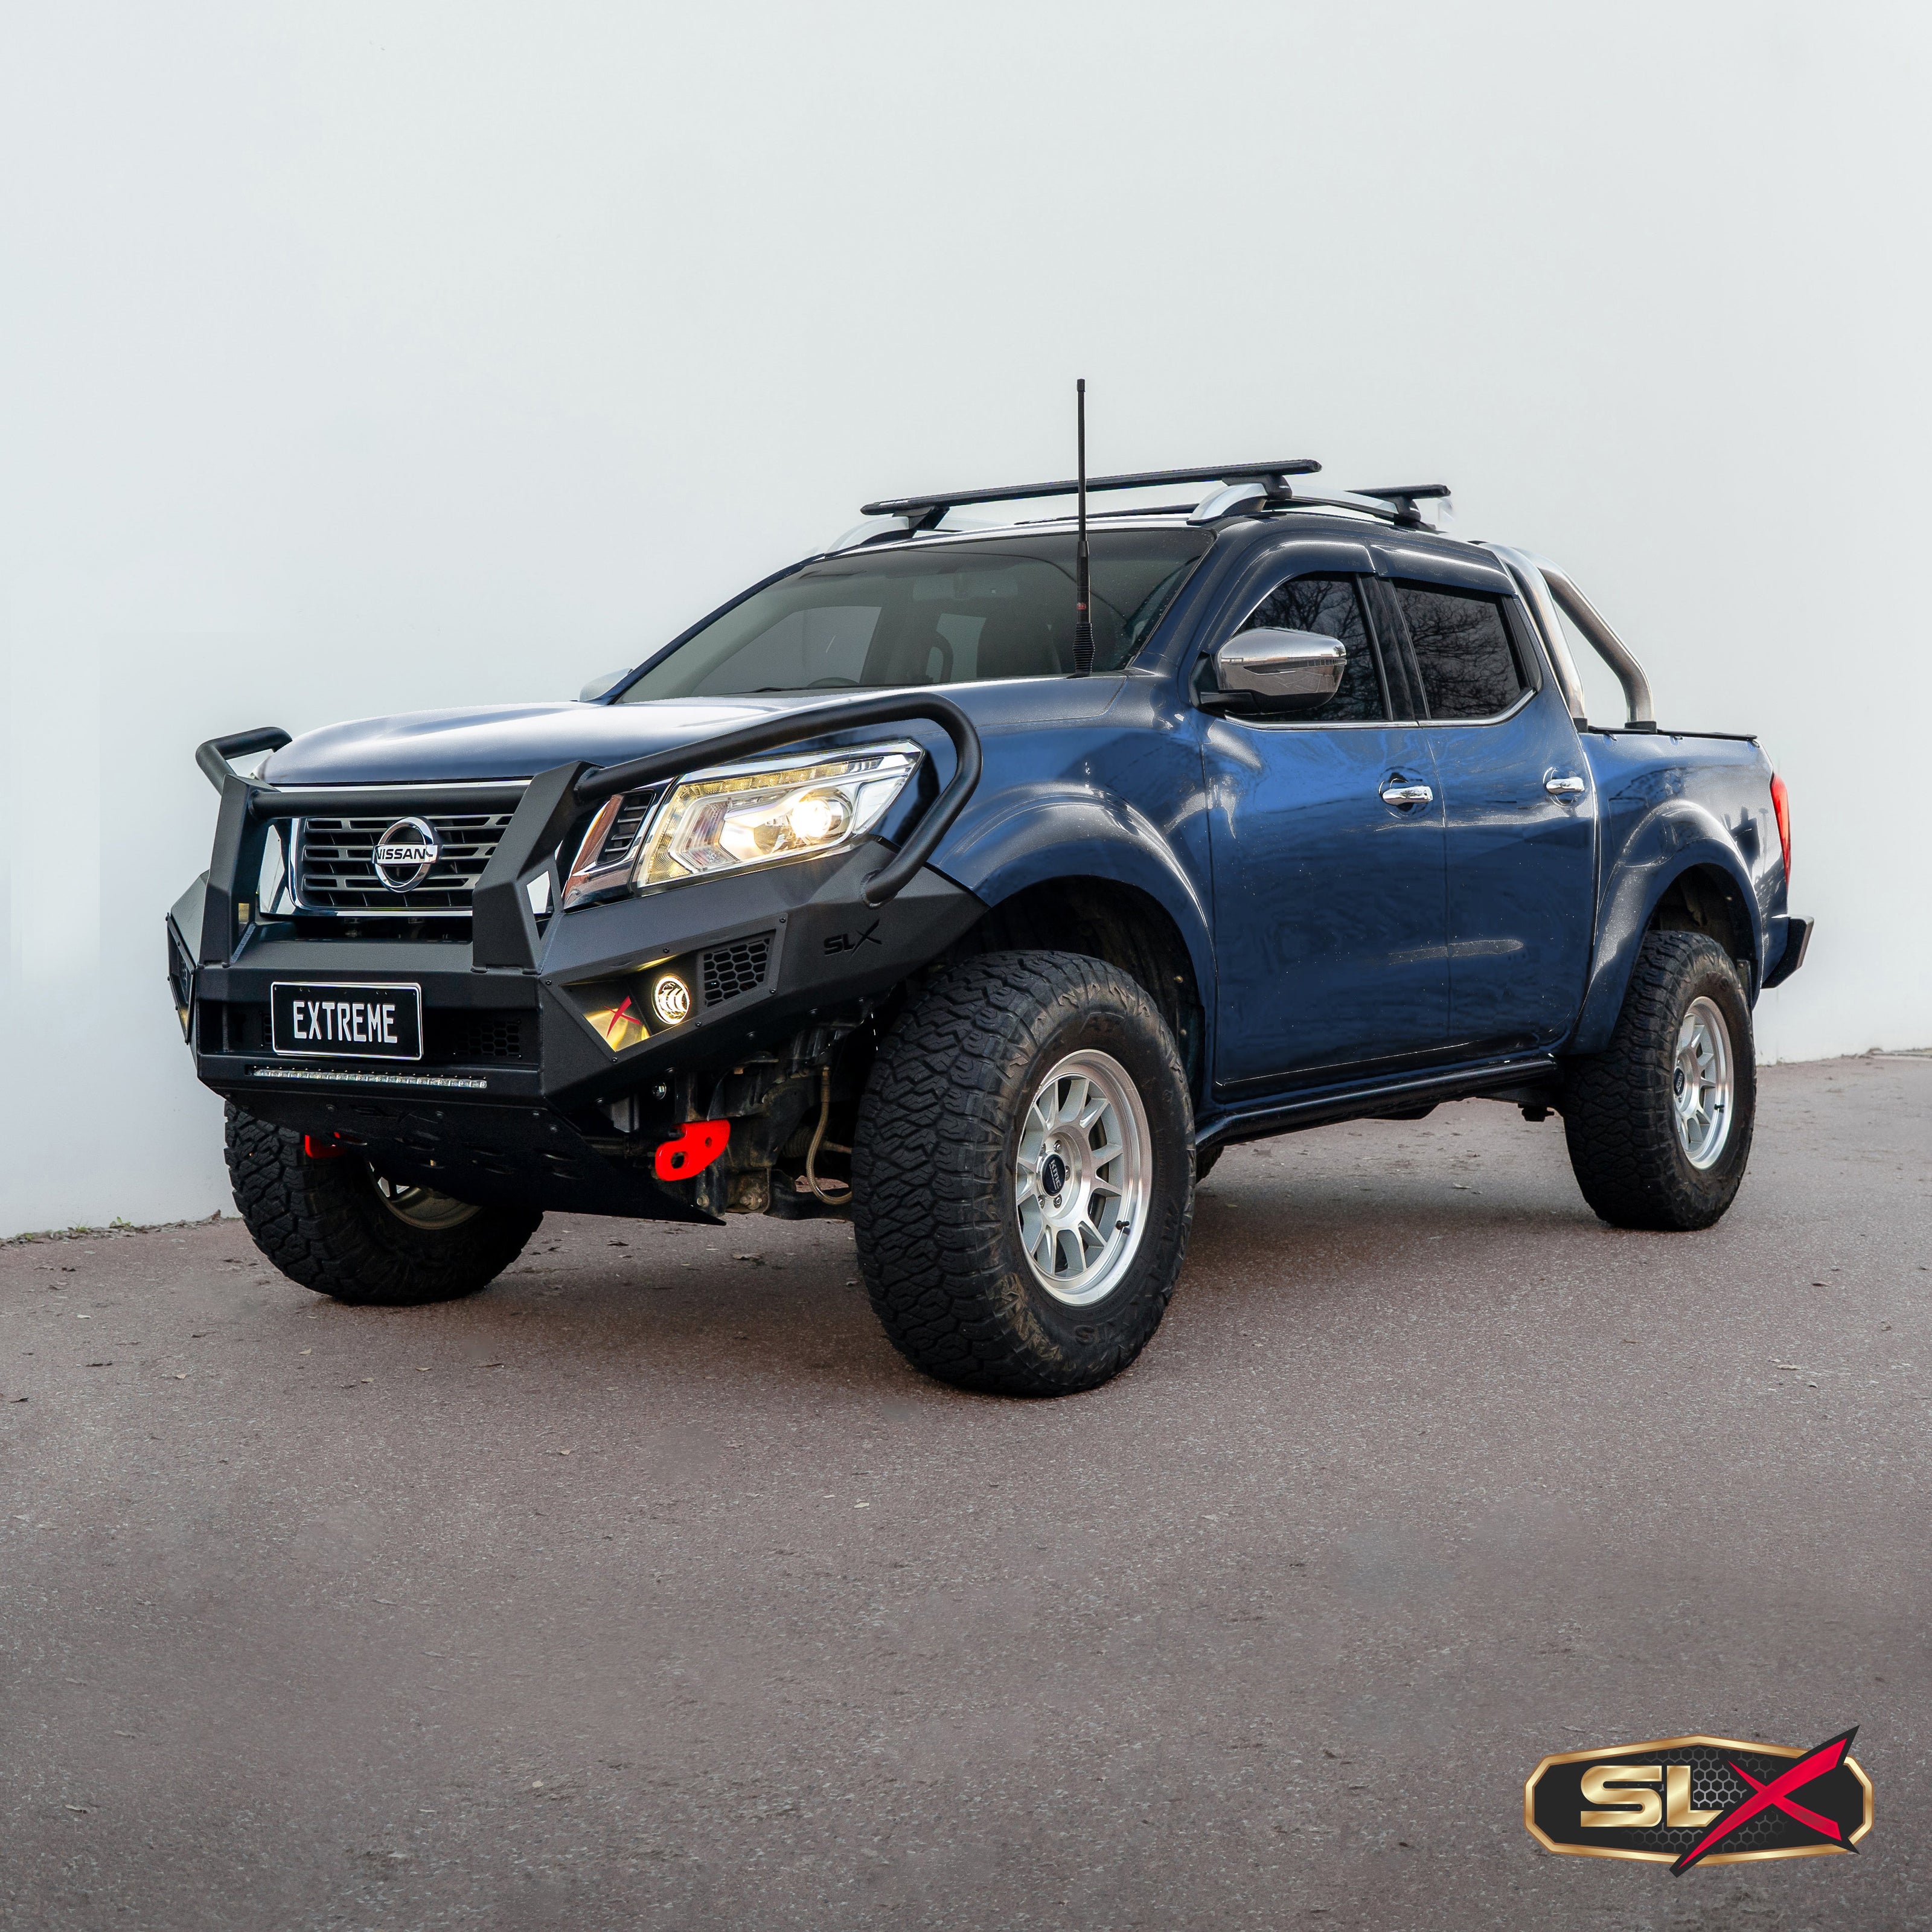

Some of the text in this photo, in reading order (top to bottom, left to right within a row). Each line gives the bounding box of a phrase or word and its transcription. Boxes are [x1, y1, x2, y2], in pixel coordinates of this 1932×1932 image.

[375, 848, 426, 860] NISSAN
[824, 919, 882, 962] SLX
[293, 1000, 398, 1044] EXTREME
